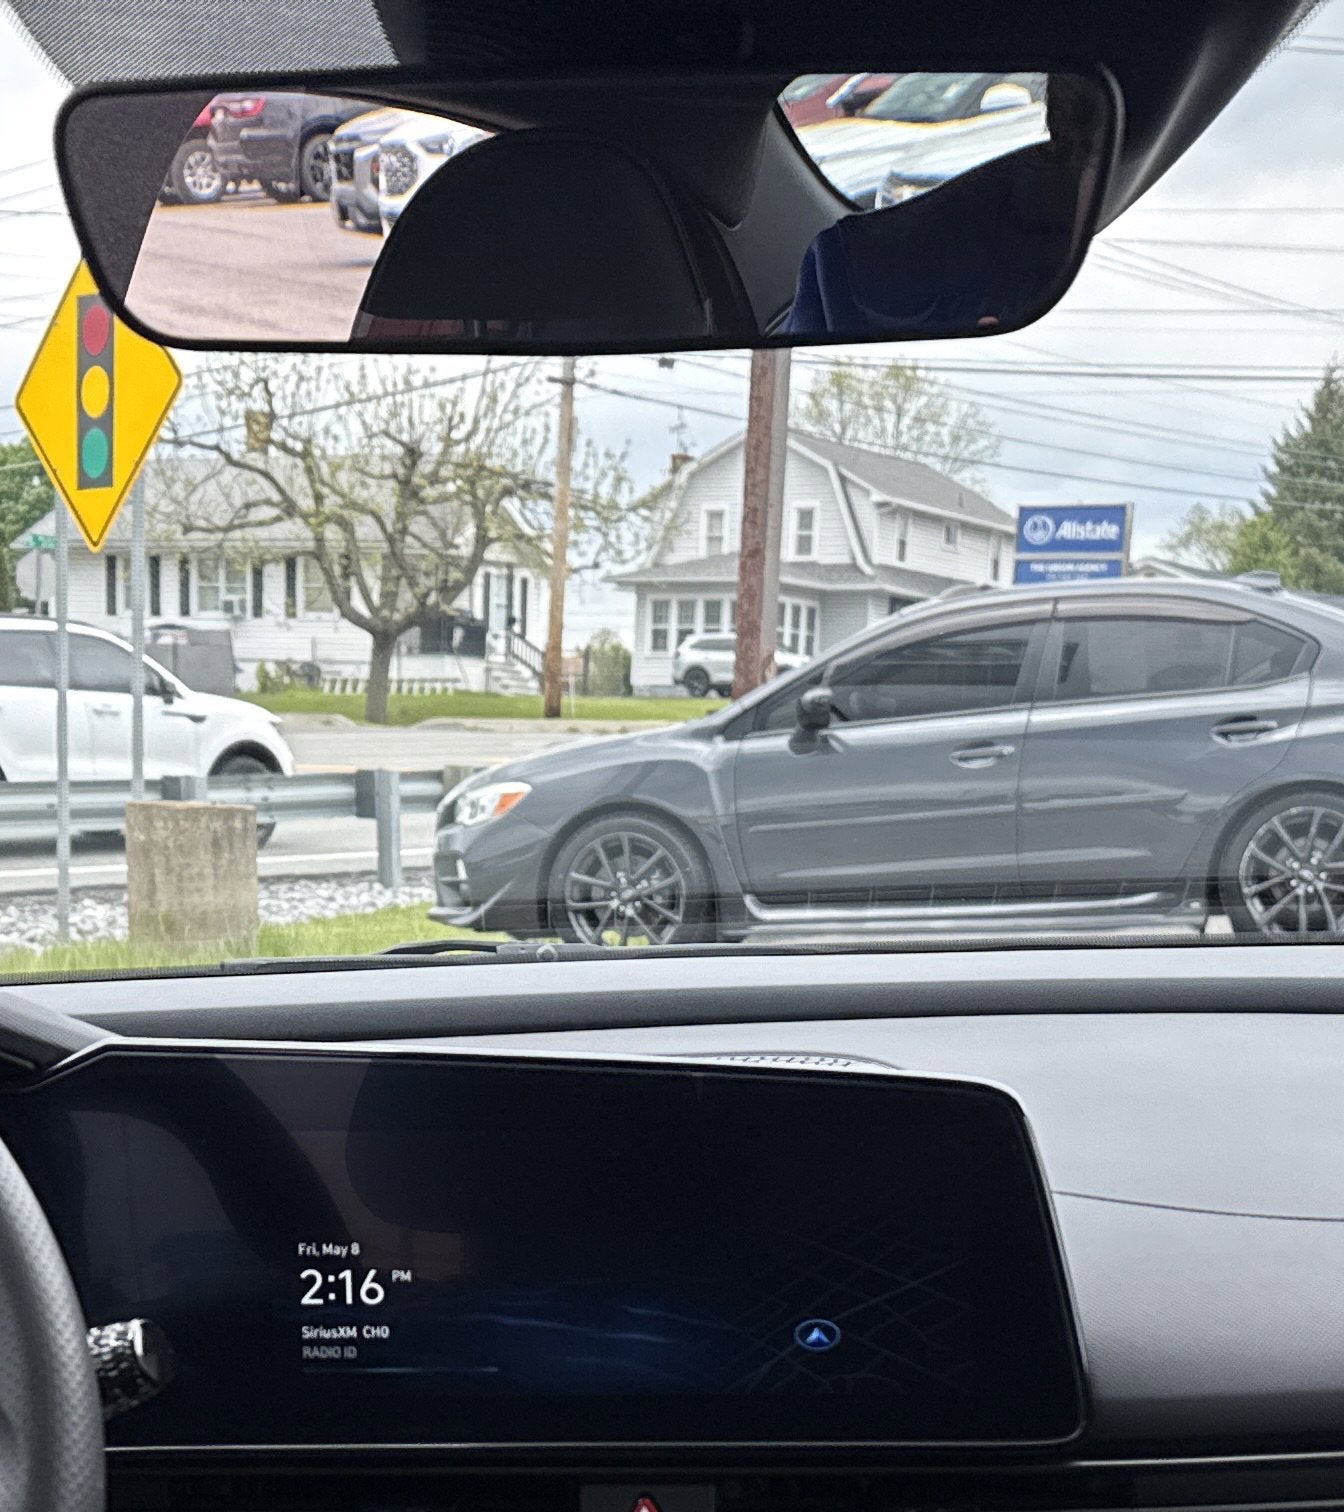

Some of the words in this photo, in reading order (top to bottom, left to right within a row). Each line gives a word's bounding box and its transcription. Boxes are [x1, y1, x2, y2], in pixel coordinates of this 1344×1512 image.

[1056, 519, 1120, 541] Allstate
[322, 1242, 348, 1258] May
[350, 1242, 361, 1256] 8
[299, 1268, 385, 1305] 2:16
[391, 1269, 412, 1283] PM
[301, 1324, 358, 1339] SiriusXM
[301, 1345, 341, 1359] RADIO
[343, 1345, 358, 1359] ID
